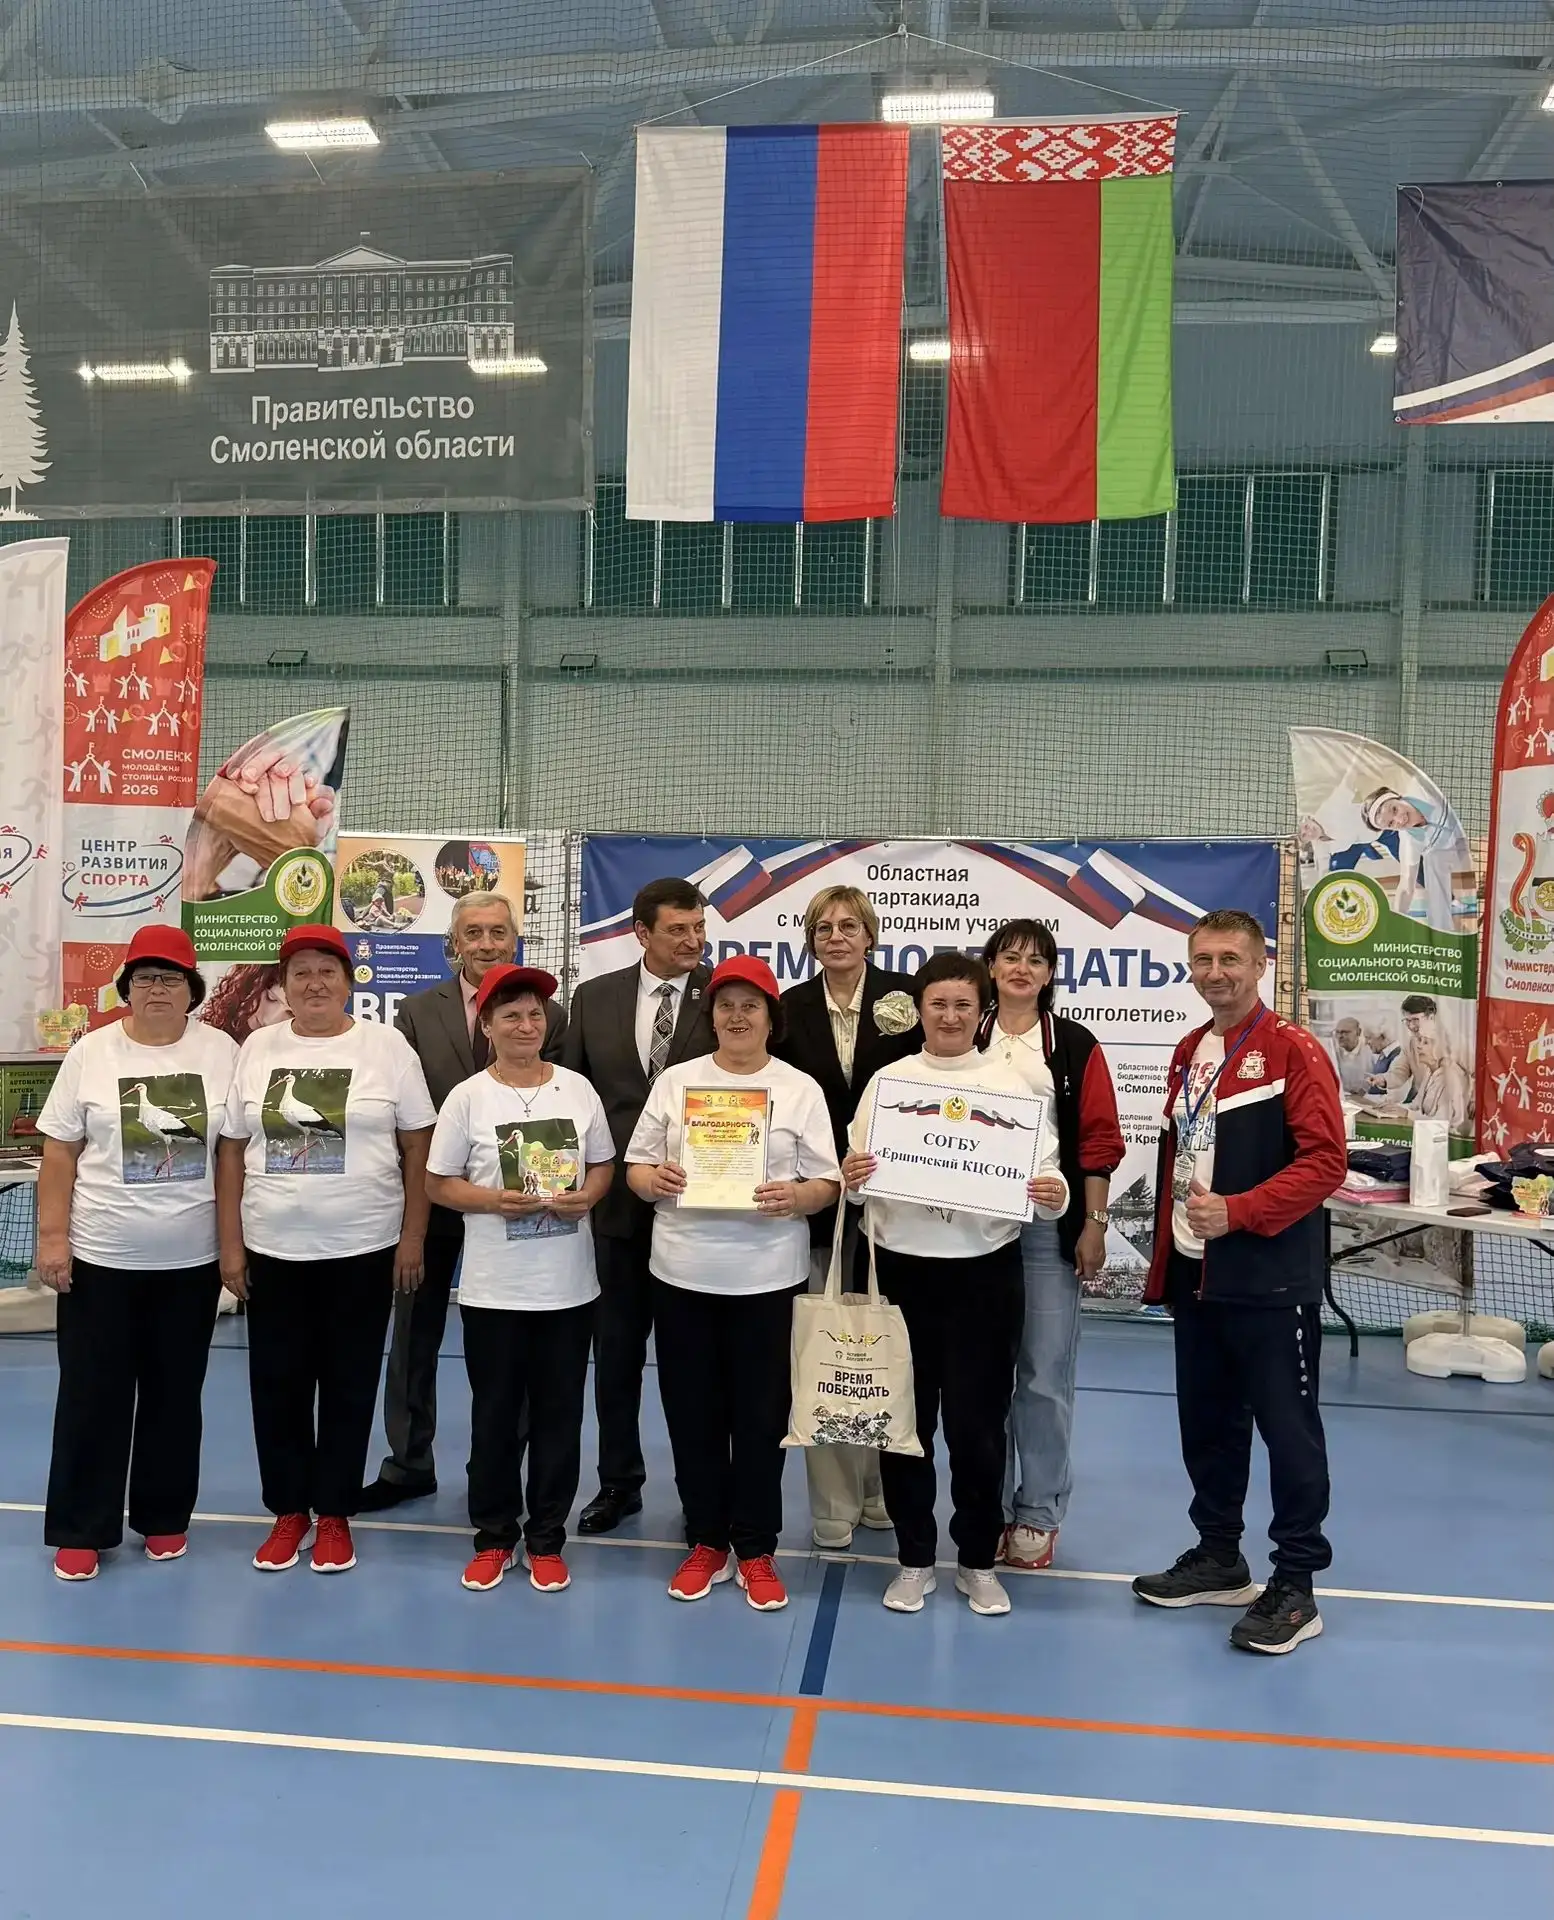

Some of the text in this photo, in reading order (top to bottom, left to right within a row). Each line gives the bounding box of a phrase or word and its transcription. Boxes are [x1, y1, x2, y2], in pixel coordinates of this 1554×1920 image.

[251, 395, 475, 430] Правительство
[210, 429, 515, 464] Смоленской области
[121, 748, 193, 763] СМОЛЕНСК
[121, 763, 180, 772] МОЛОДЁЖНА
[121, 773, 165, 783] СТОЛИЦА
[121, 784, 159, 796] 2026
[81, 839, 138, 854] ЦЕНТР
[81, 856, 168, 870] РАЗВИТИЯ
[81, 873, 149, 886] СПОРТА
[866, 864, 969, 882] Областная
[867, 890, 980, 908] партакиада
[194, 914, 278, 924] МИНИСТЕРСТВО
[777, 913, 787, 927] с
[194, 928, 274, 939] СОЦИАЛЬНОГО
[193, 940, 266, 952] СМОЛЕНСКОЙ
[1373, 943, 1462, 959] МИНИСТЕРСТВО
[1317, 958, 1462, 974] СОЦИАЛЬНОГО РАЗВИТИЯ
[1505, 958, 1554, 976] Министер
[1329, 971, 1462, 988] СМОЛЕНСКОЙ ОБЛАСТИ
[1505, 977, 1554, 994] Смоленско
[1059, 1006, 1187, 1023] долголетие»
[1117, 1063, 1159, 1072] Областное
[1117, 1073, 1161, 1082] бюджетное
[1117, 1083, 1169, 1095] «Смолен
[691, 1120, 756, 1128] БЛАГОДАРНОСТЬ
[1119, 1114, 1153, 1122] деление
[1132, 1124, 1161, 1132] органи
[923, 1132, 981, 1152] СОГБУ
[1135, 1133, 1161, 1146] Кре
[874, 1147, 1026, 1181] «Ершичский КЦСОН»
[834, 1370, 873, 1385] ВРЕМЯ
[817, 1381, 890, 1400] ПОБЕЖДАТЬ
